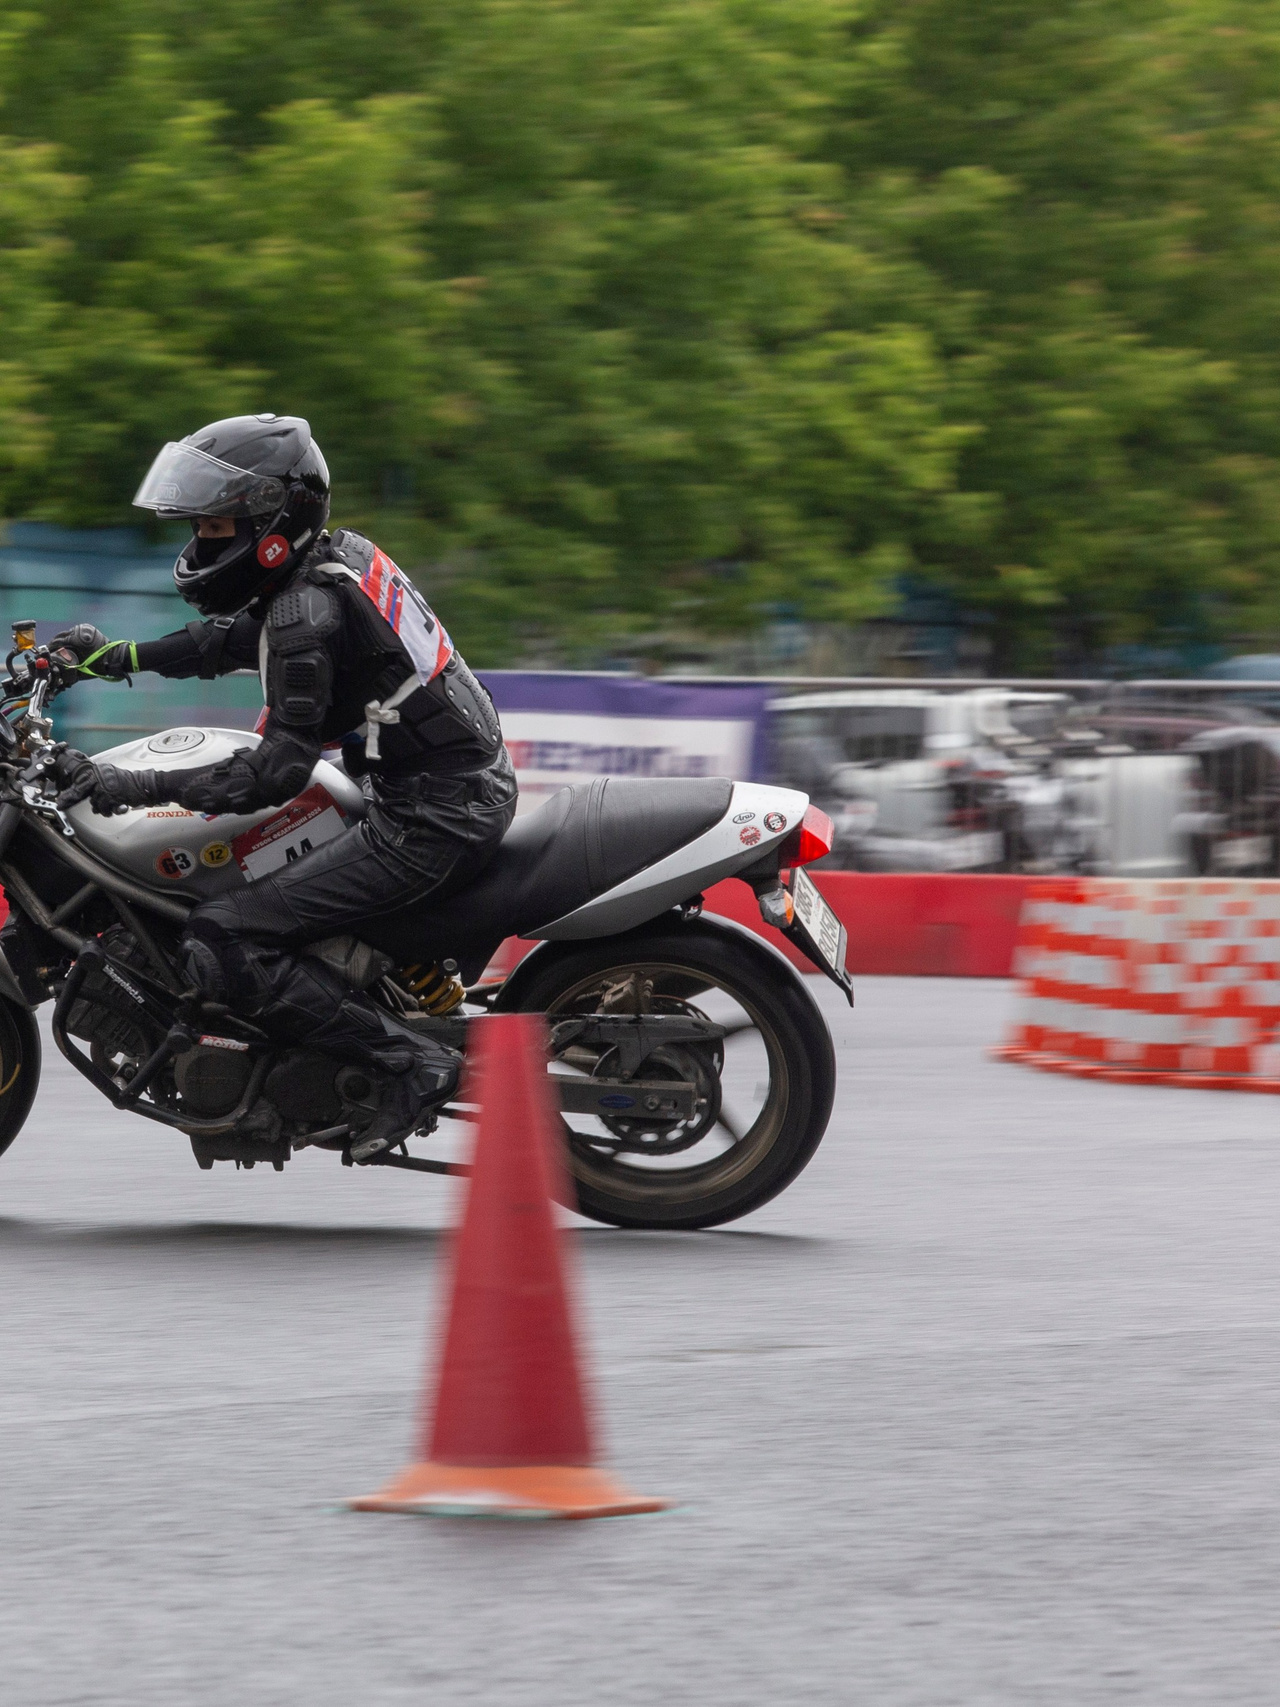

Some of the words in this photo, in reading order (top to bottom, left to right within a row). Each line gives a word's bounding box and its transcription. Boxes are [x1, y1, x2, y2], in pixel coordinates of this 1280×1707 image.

[264, 542, 283, 562] 21
[146, 810, 194, 818] HONDA
[307, 806, 322, 821] 2024
[208, 848, 224, 861] 12
[795, 873, 814, 925] 3851
